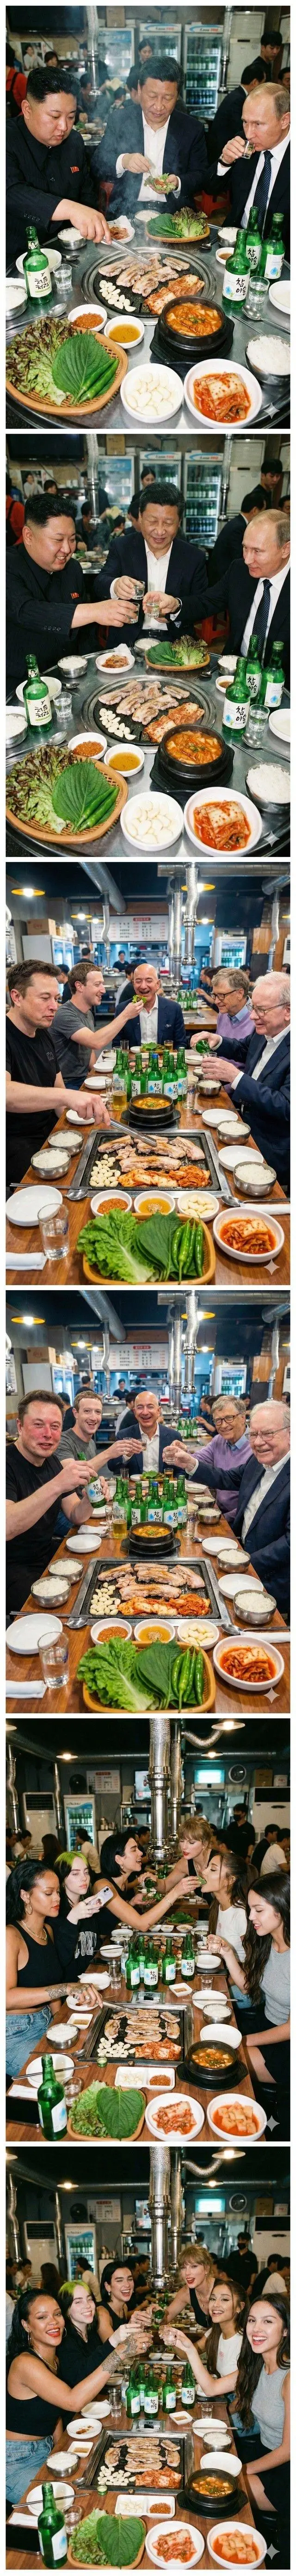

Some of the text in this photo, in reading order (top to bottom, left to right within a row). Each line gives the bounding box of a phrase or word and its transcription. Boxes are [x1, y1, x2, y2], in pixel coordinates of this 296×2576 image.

[247, 248, 256, 257] 참
[236, 278, 245, 287] 참
[236, 286, 246, 296] 이슬
[247, 677, 256, 685] 참
[236, 706, 245, 715] 참
[236, 714, 246, 724] 이슬
